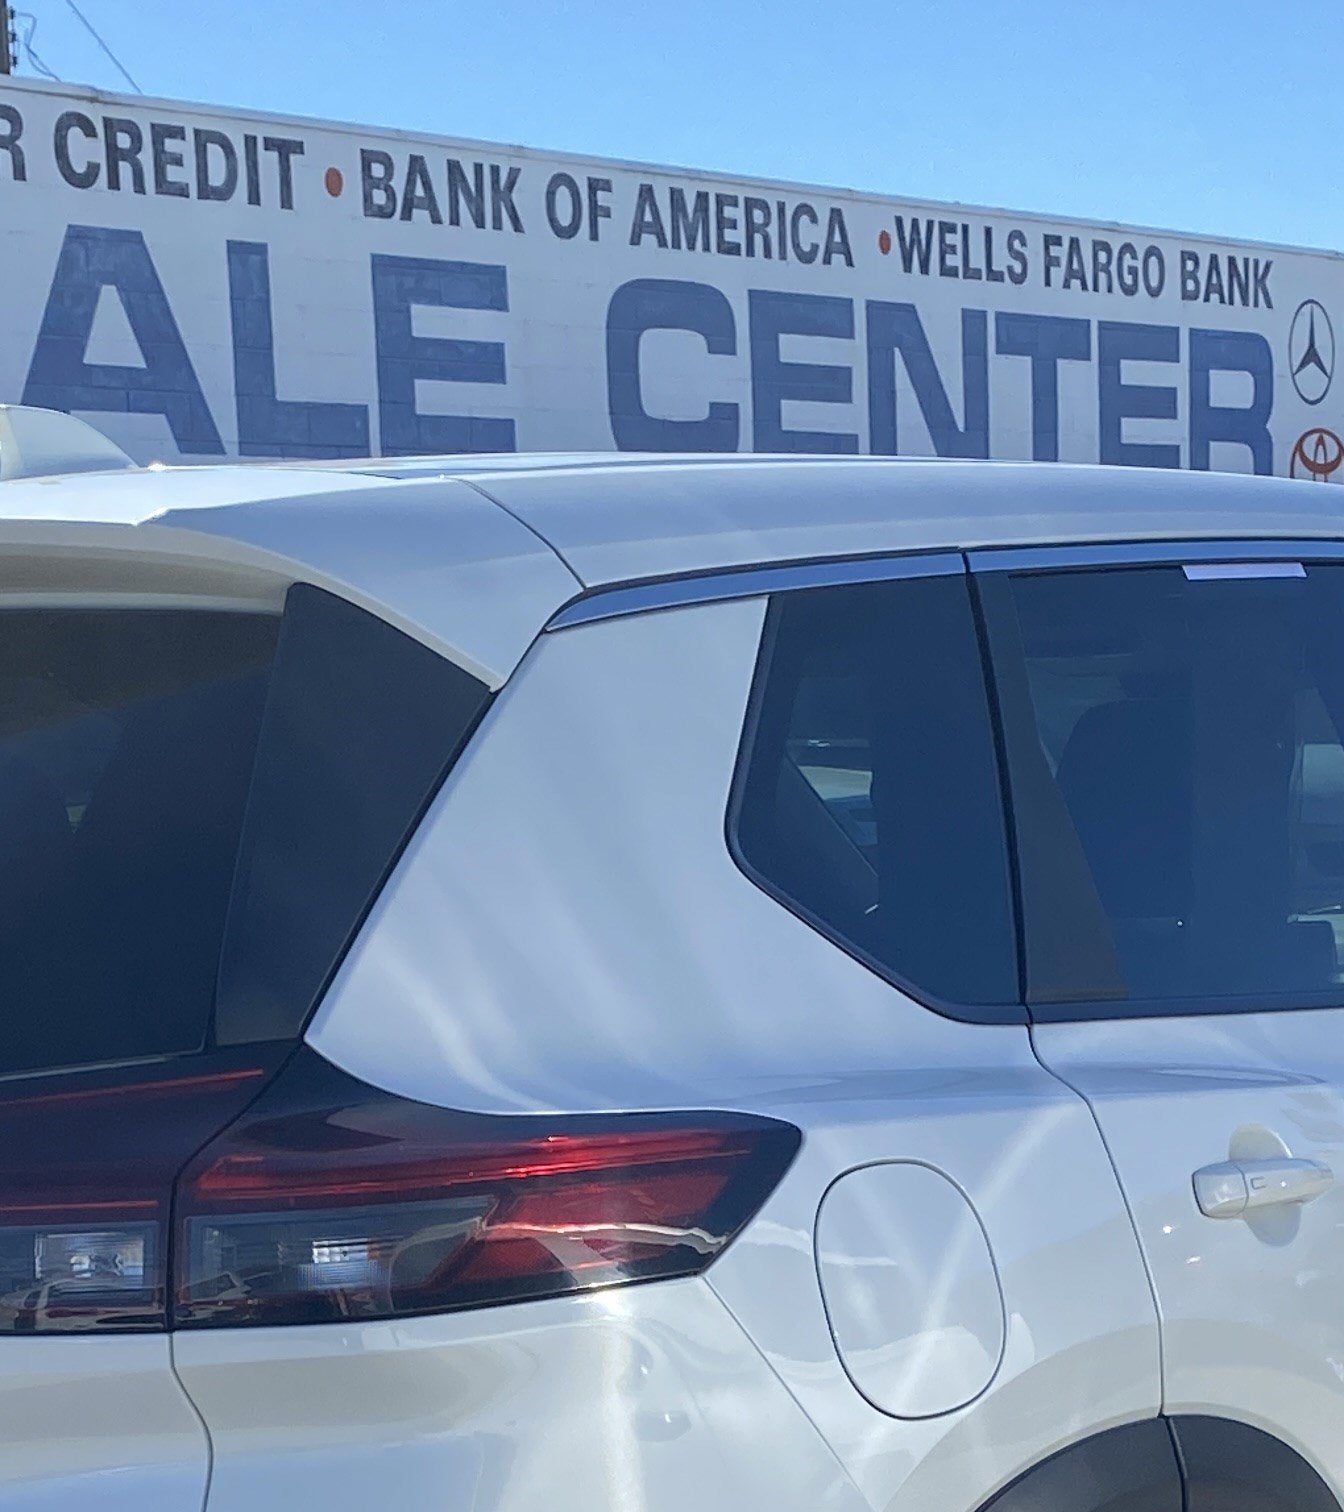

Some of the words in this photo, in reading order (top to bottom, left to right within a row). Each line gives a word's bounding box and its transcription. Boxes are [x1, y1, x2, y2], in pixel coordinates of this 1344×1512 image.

[54, 110, 305, 211] CREDIT
[359, 148, 526, 234] BANK
[545, 172, 613, 241] OF
[630, 183, 855, 268] AMERICA
[893, 214, 1029, 284] WELLS
[1043, 234, 1166, 298] FARGO
[1181, 250, 1275, 309] BANK
[605, 278, 1275, 476] CENTER
